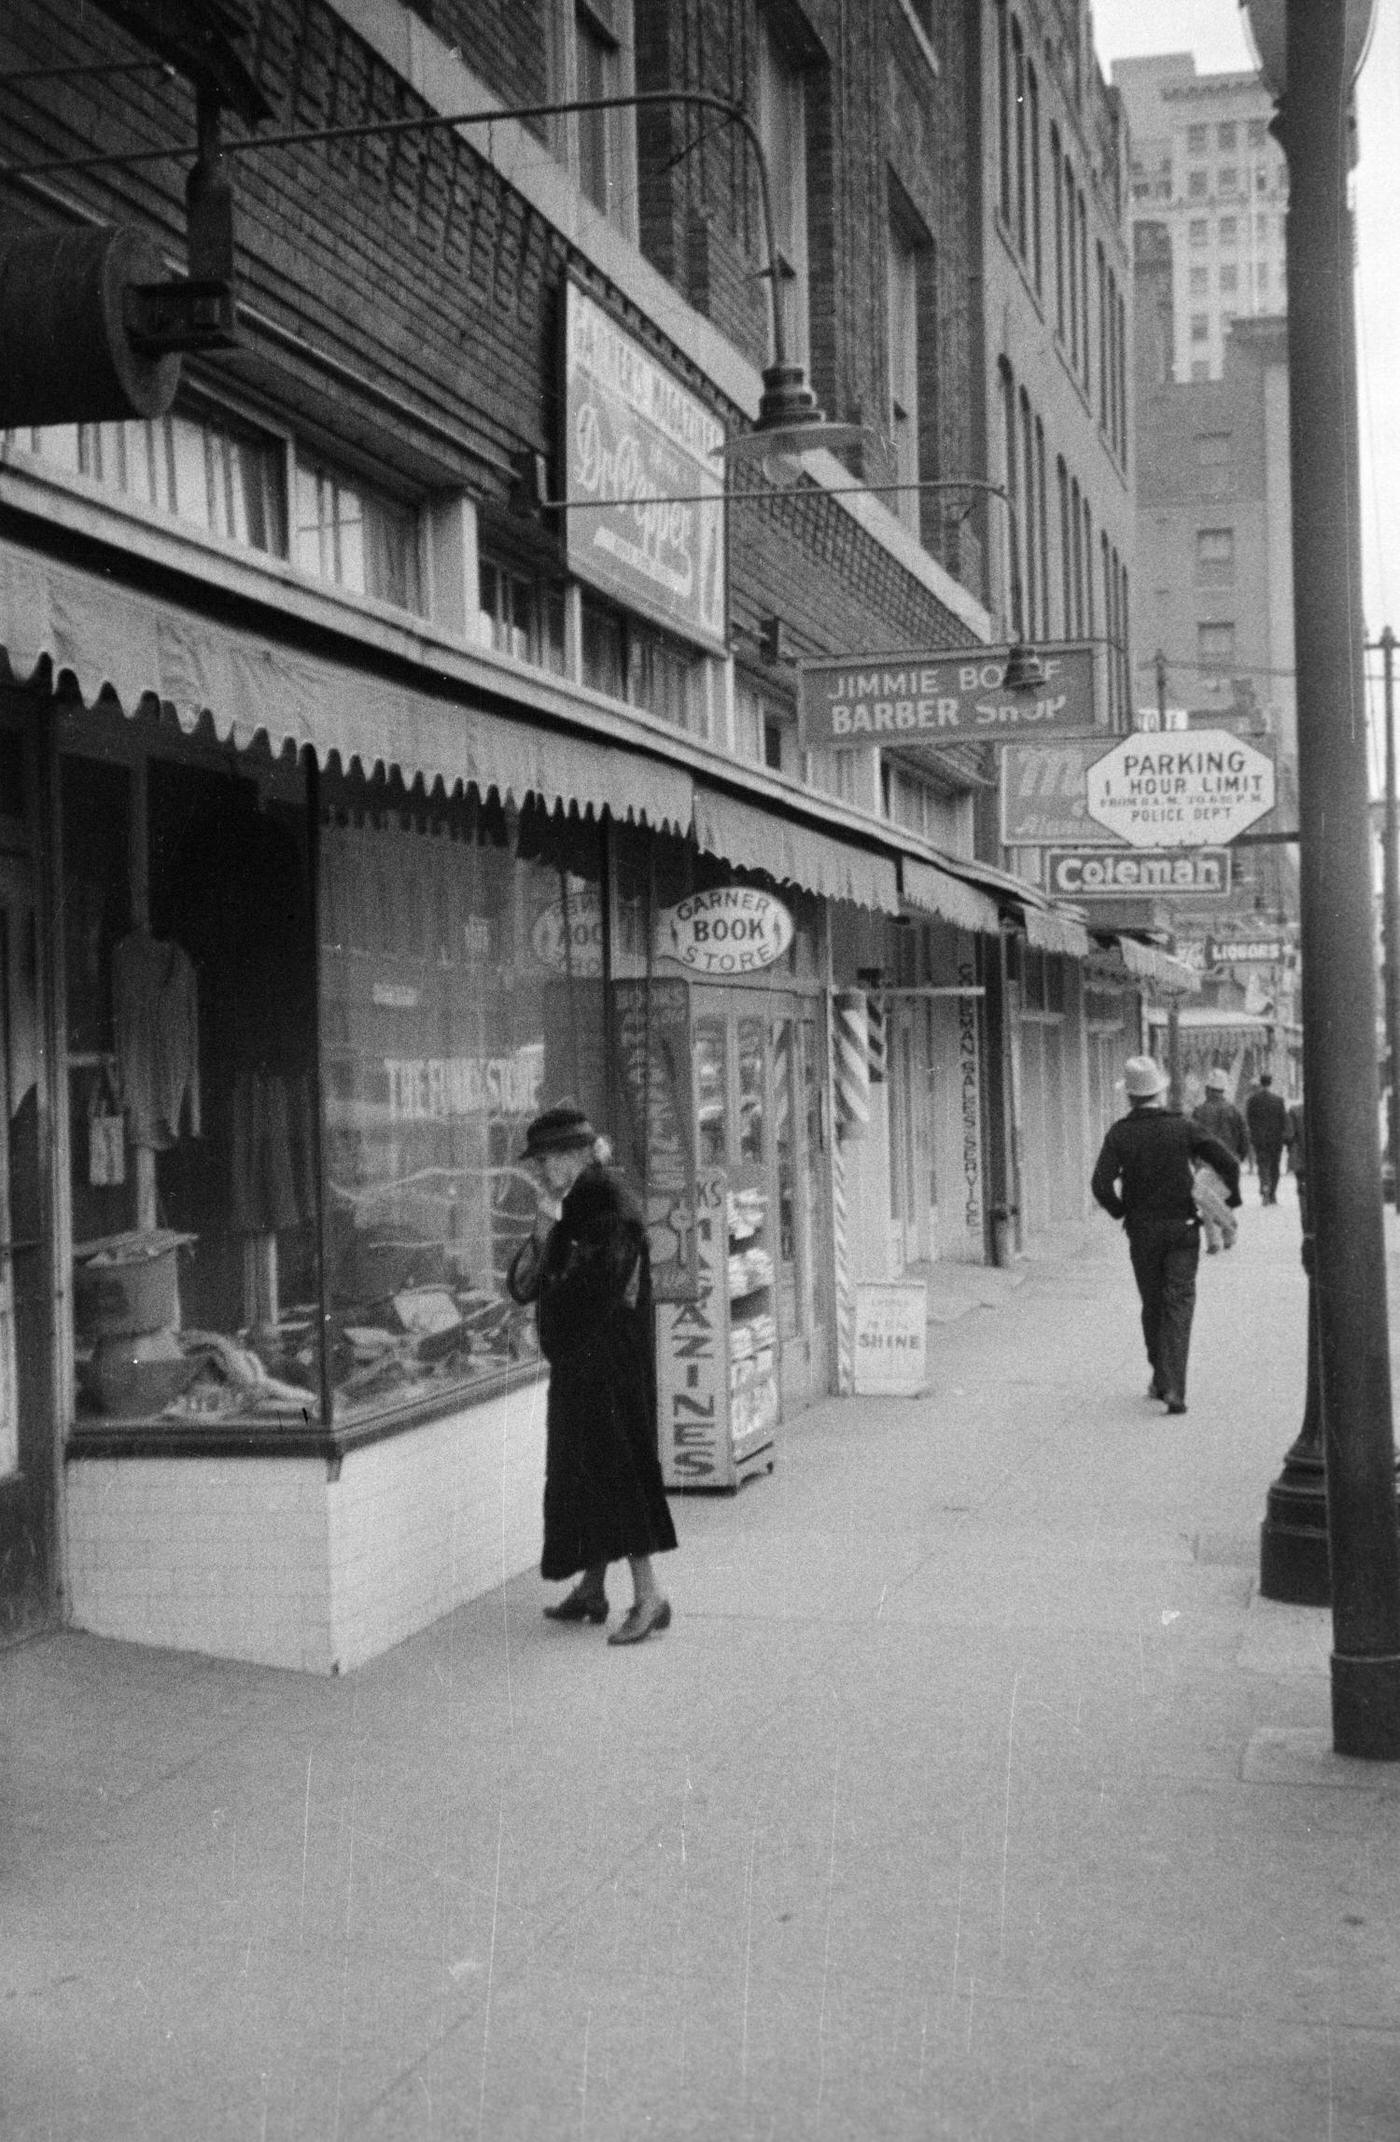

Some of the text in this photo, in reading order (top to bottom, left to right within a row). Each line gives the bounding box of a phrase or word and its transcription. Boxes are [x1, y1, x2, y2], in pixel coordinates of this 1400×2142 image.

[826, 668, 940, 700] JIMMIE
[831, 698, 960, 735] BARBER
[1123, 751, 1246, 776] PARKING
[1130, 777, 1187, 795] HOUR
[1202, 774, 1263, 793] LIMIT
[1131, 807, 1185, 822] POLICE
[1056, 857, 1220, 890] Coleman
[676, 891, 771, 921] GARNER
[693, 919, 765, 942] BOOK
[682, 943, 774, 970] STORE
[858, 1332, 920, 1349] SHINE
